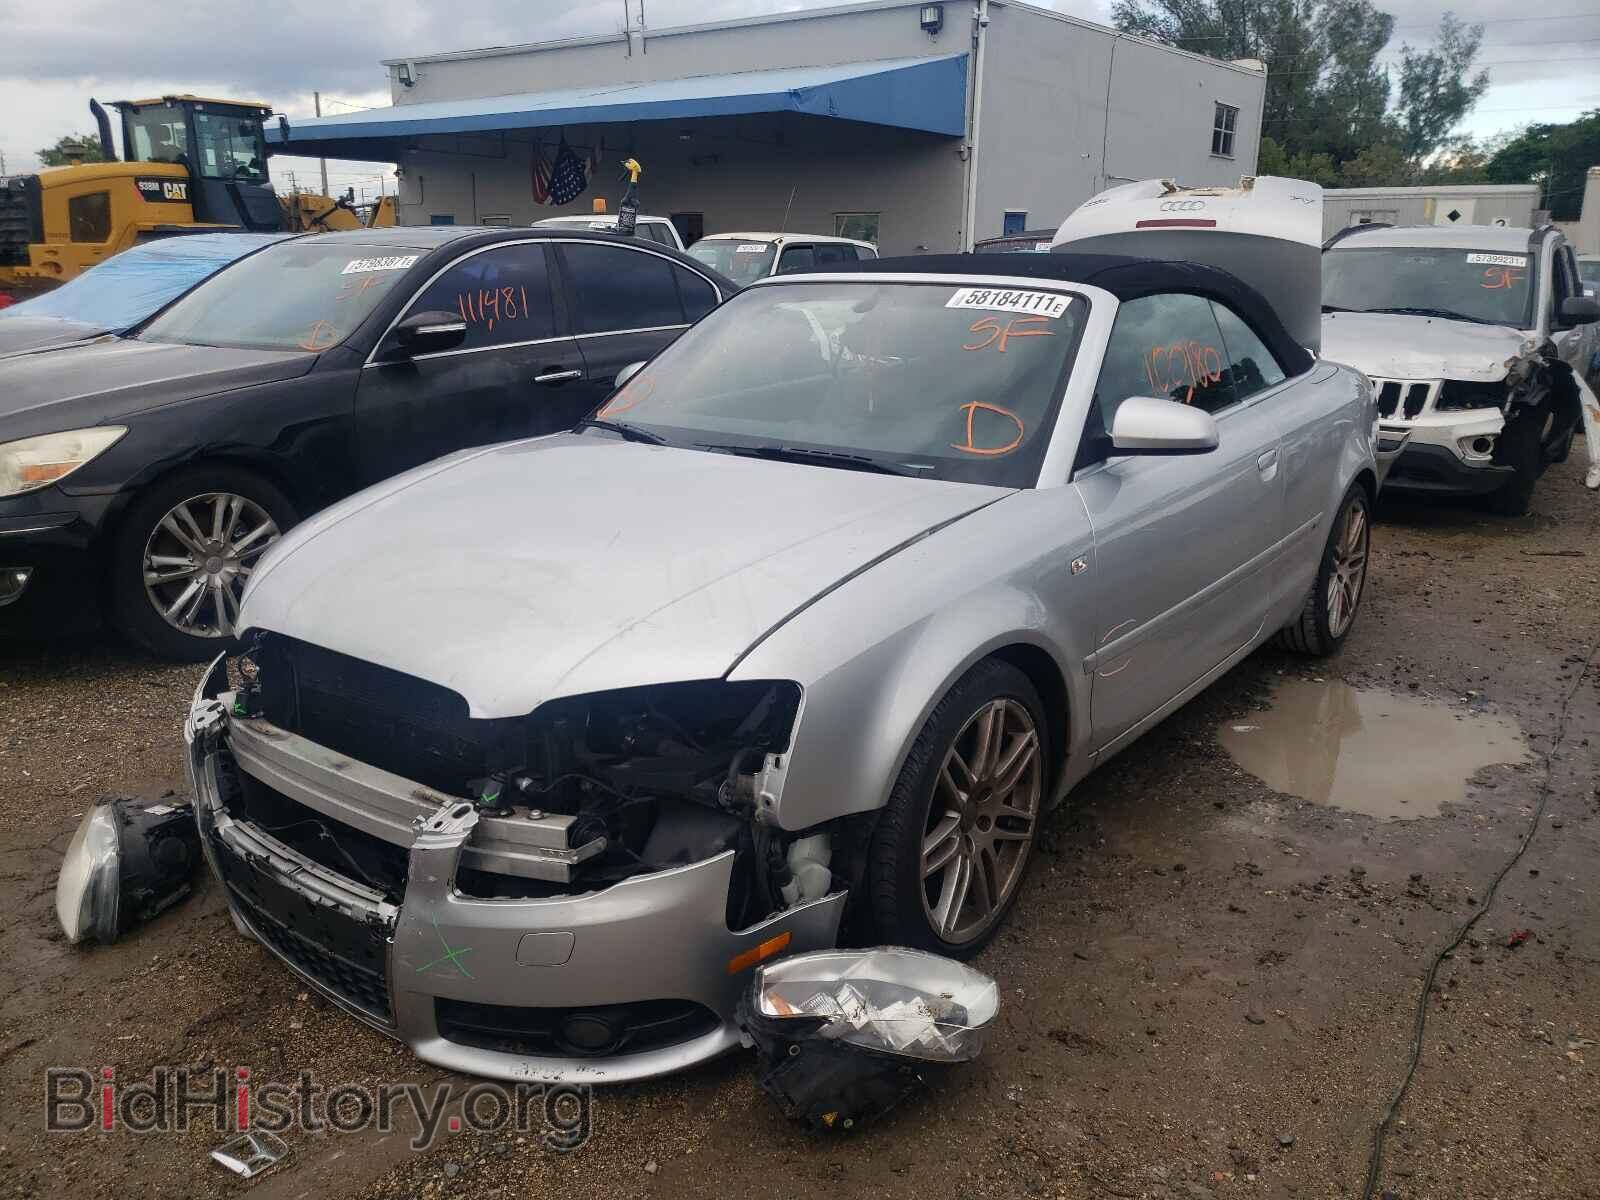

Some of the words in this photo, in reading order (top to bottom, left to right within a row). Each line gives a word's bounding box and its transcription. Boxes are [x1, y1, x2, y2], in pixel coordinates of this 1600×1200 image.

[163, 182, 187, 200] CAT
[960, 316, 1056, 352] SF
[950, 400, 1025, 456] D
